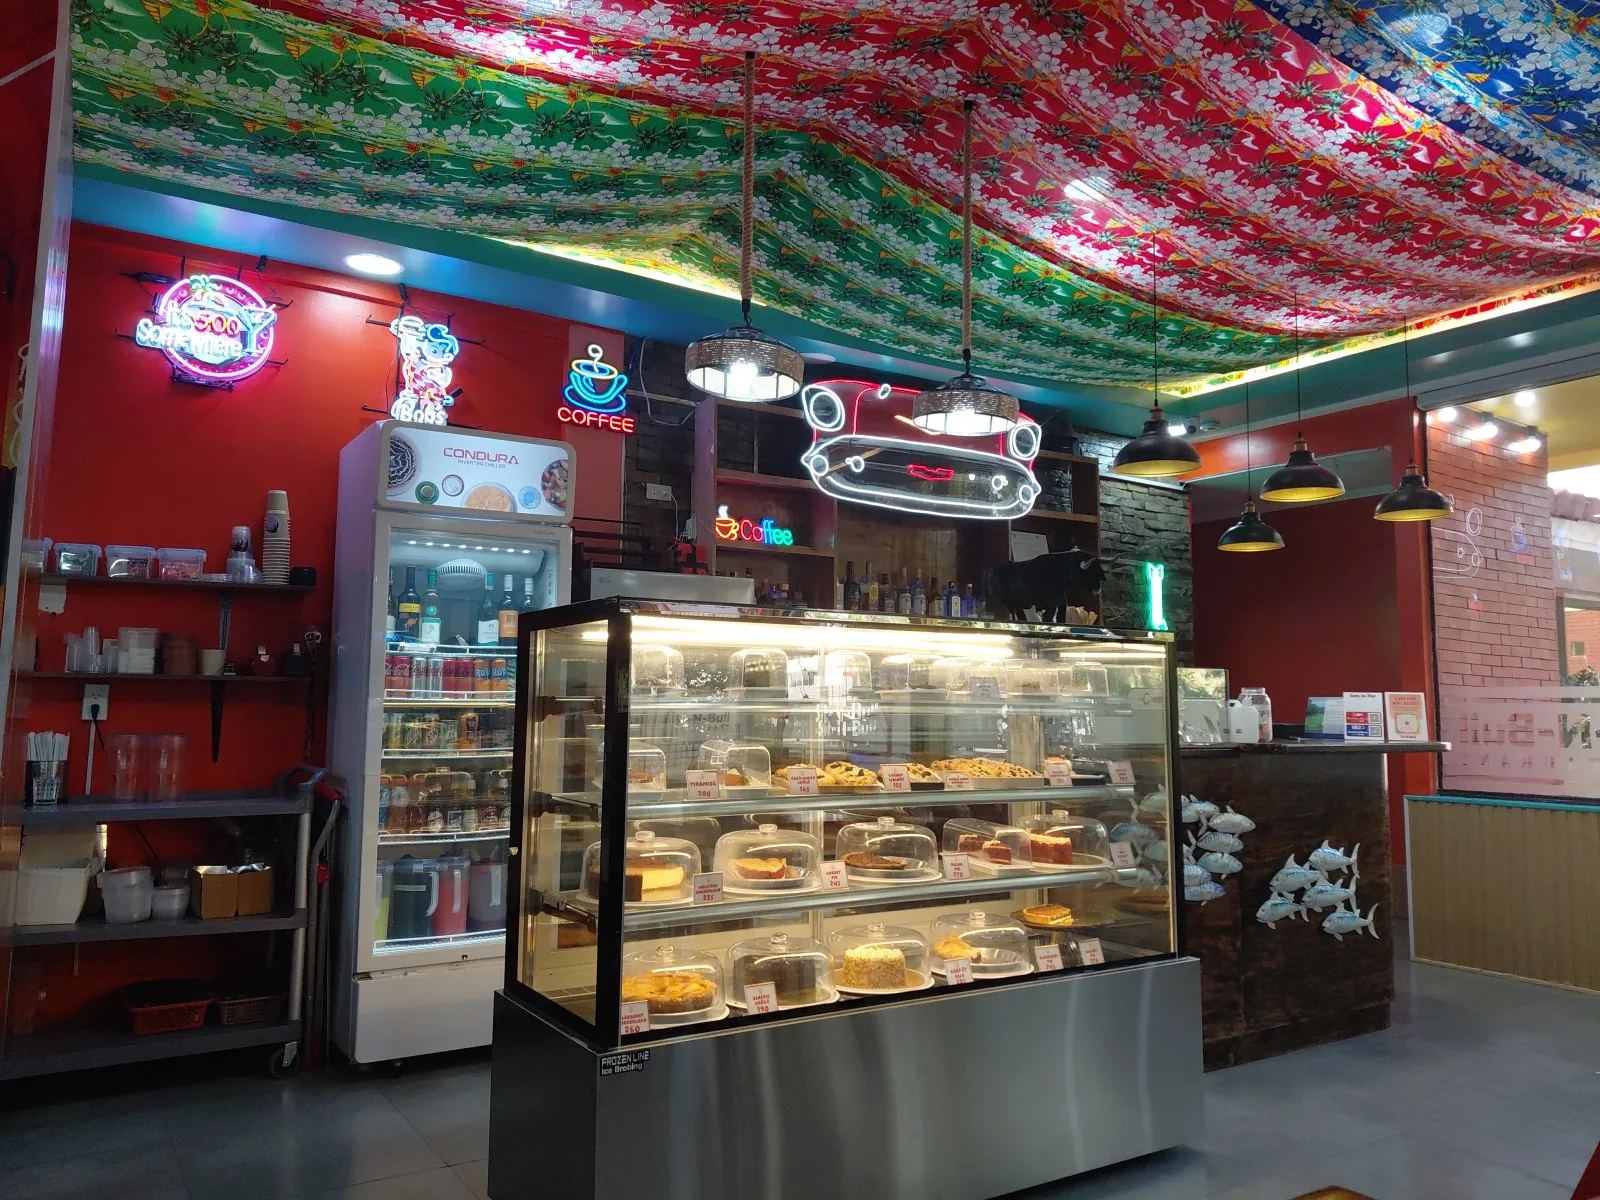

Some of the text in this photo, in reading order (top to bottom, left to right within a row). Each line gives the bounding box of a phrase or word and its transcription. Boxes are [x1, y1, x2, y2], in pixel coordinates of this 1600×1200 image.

[136, 318, 243, 357] Somewhere
[557, 407, 634, 433] COFFEE
[443, 447, 519, 465] CONDURA
[741, 519, 793, 546] Coffee
[624, 1025, 640, 1033] 260
